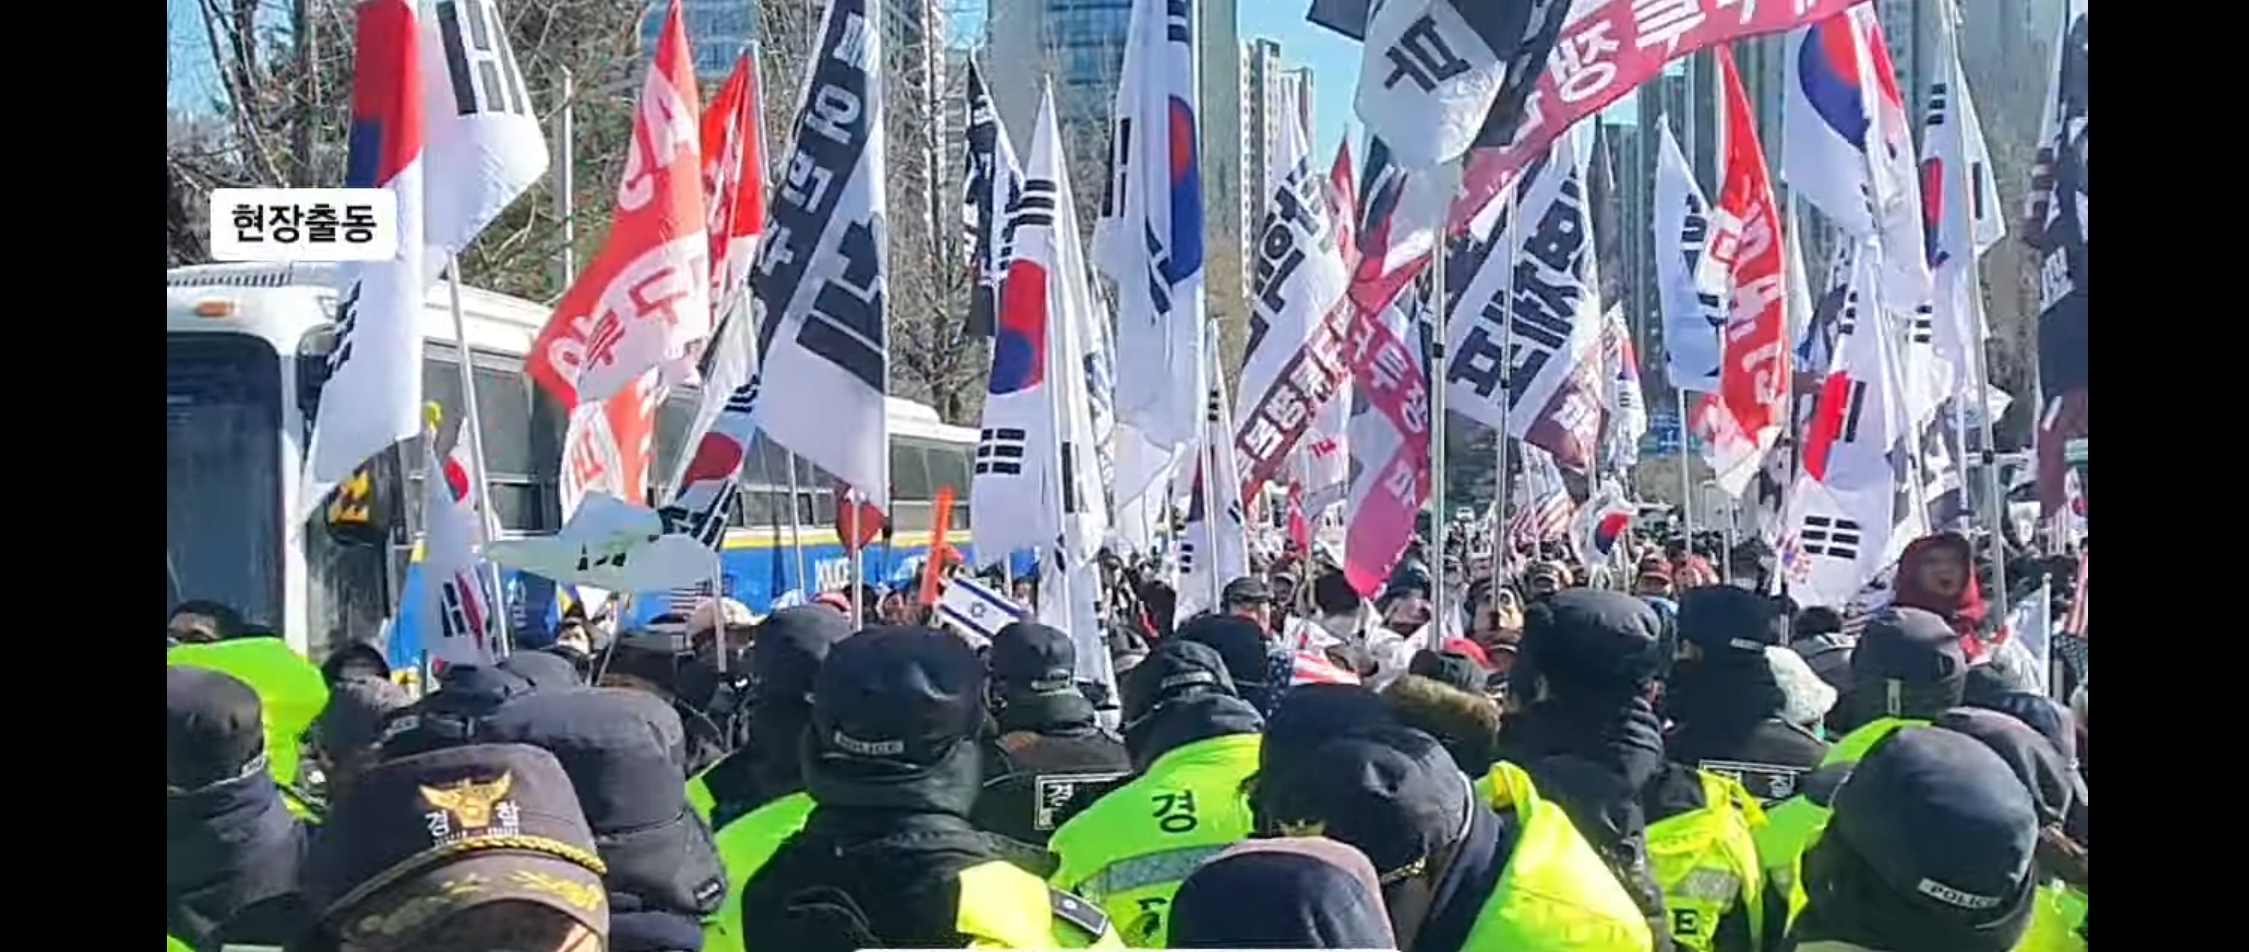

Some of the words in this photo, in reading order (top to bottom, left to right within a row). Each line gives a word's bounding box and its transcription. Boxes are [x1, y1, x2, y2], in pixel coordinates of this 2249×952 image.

[425, 808, 450, 838] 경
[494, 799, 521, 828] 찰
[1151, 788, 1198, 833] 경
